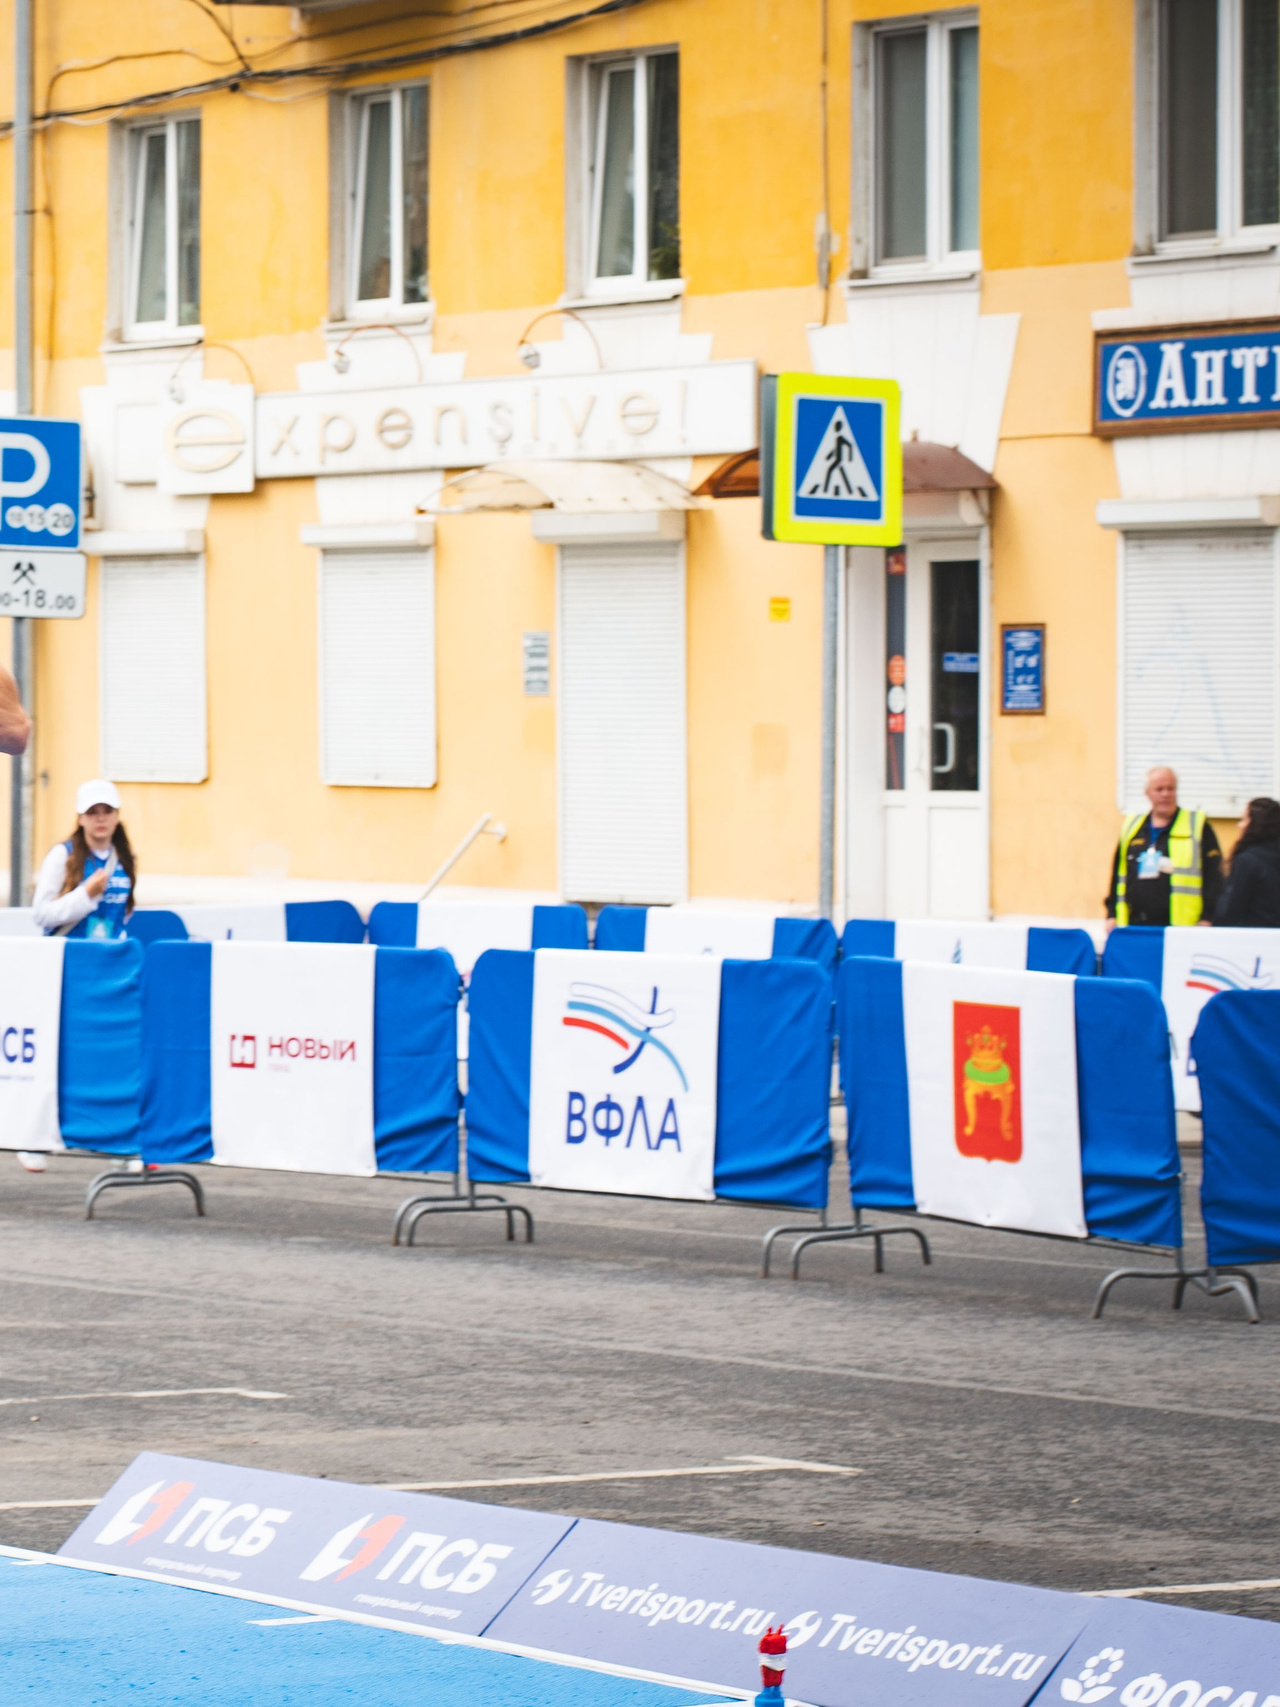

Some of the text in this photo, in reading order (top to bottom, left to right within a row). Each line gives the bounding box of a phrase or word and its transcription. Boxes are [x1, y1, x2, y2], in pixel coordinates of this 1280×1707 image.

[52, 512, 73, 529] 20
[566, 1091, 682, 1152] ВФЛА
[164, 1497, 514, 1594] ПСБ ПСБ
[568, 1571, 1047, 1681] Tverisport.ru Tverisport.ru
